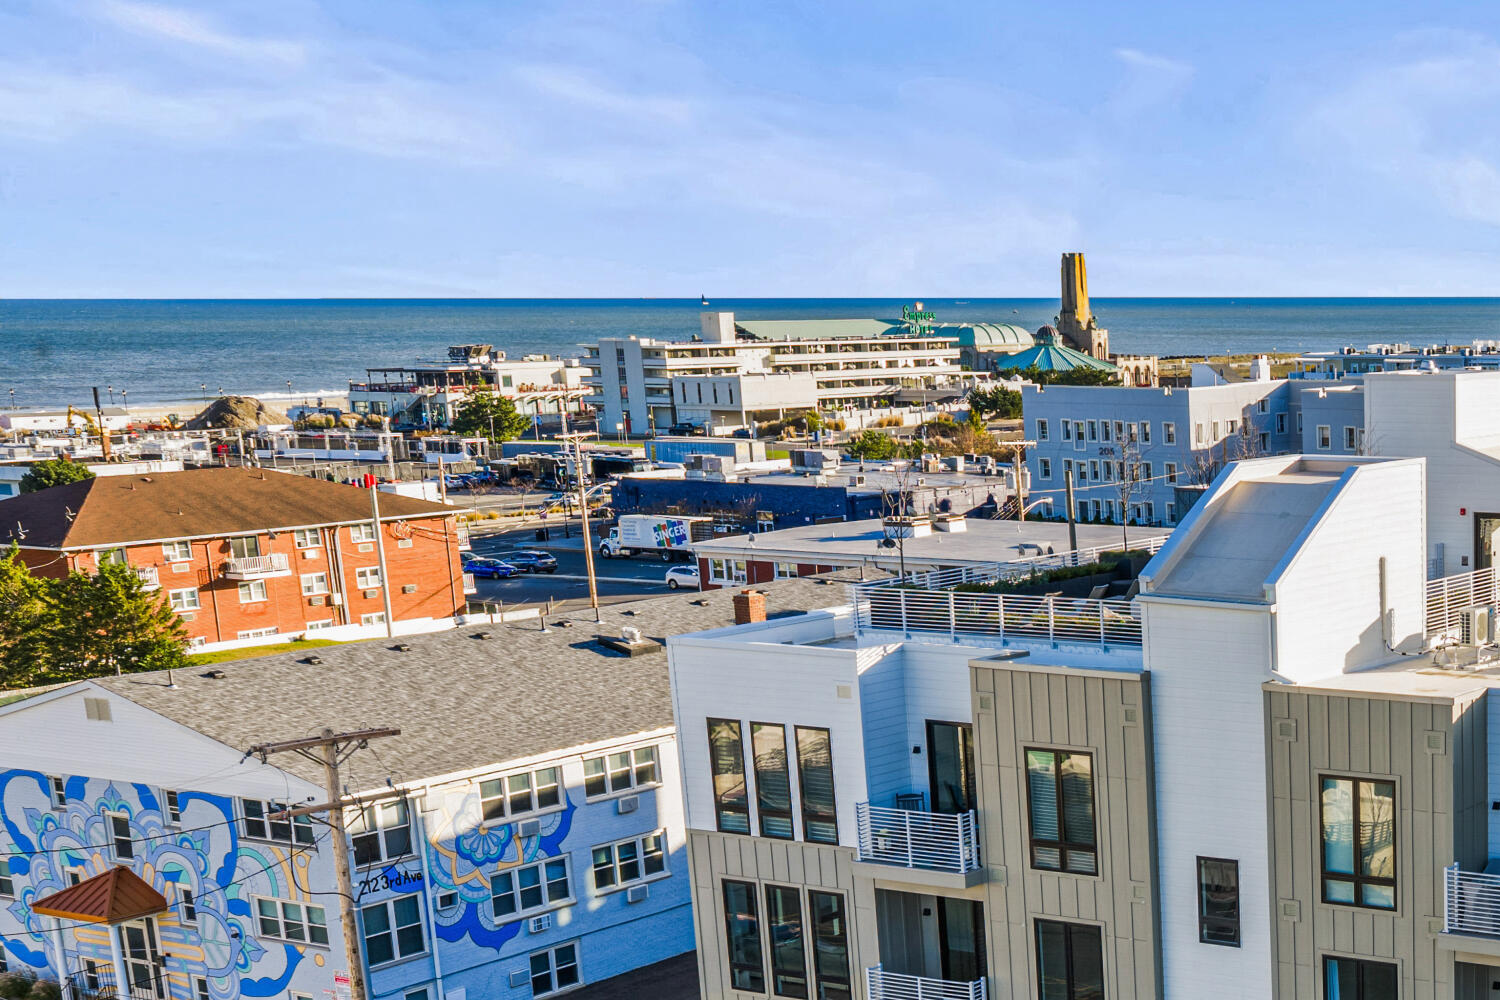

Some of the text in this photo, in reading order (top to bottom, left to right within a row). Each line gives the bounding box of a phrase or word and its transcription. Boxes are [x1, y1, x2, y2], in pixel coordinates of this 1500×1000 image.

[653, 525, 687, 541] SINGER
[359, 870, 423, 896] 212 3rd Ave
